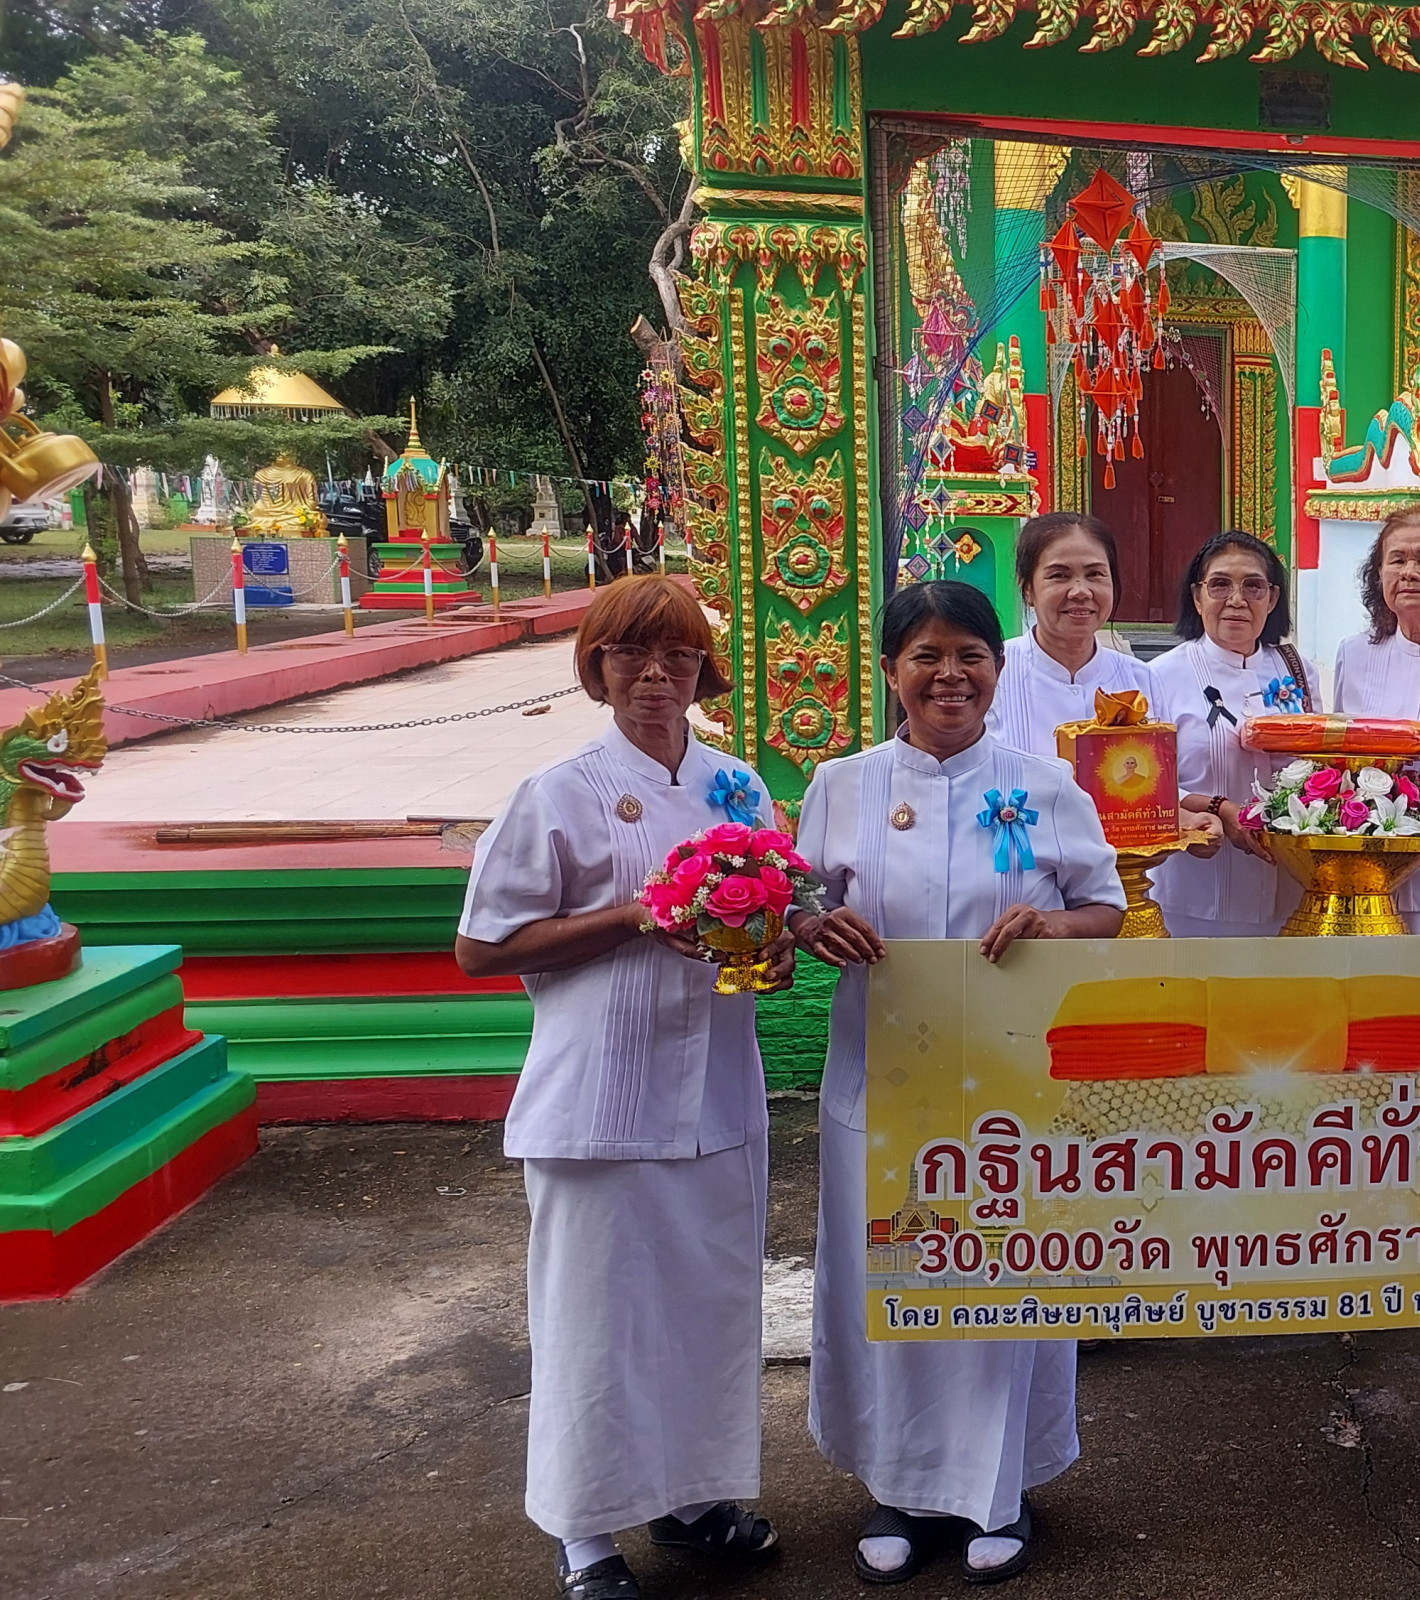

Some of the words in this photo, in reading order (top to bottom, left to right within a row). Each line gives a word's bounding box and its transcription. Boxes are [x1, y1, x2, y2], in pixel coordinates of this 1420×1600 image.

[920, 1219, 1171, 1281] 30,000วัด
[886, 1297, 940, 1328] โดย
[953, 1293, 1185, 1333] คณะศิษยานุศิษย์
[1197, 1299, 1327, 1331] บูชาธรรม
[1338, 1294, 1372, 1317] 81
[1384, 1285, 1403, 1314] ปี
